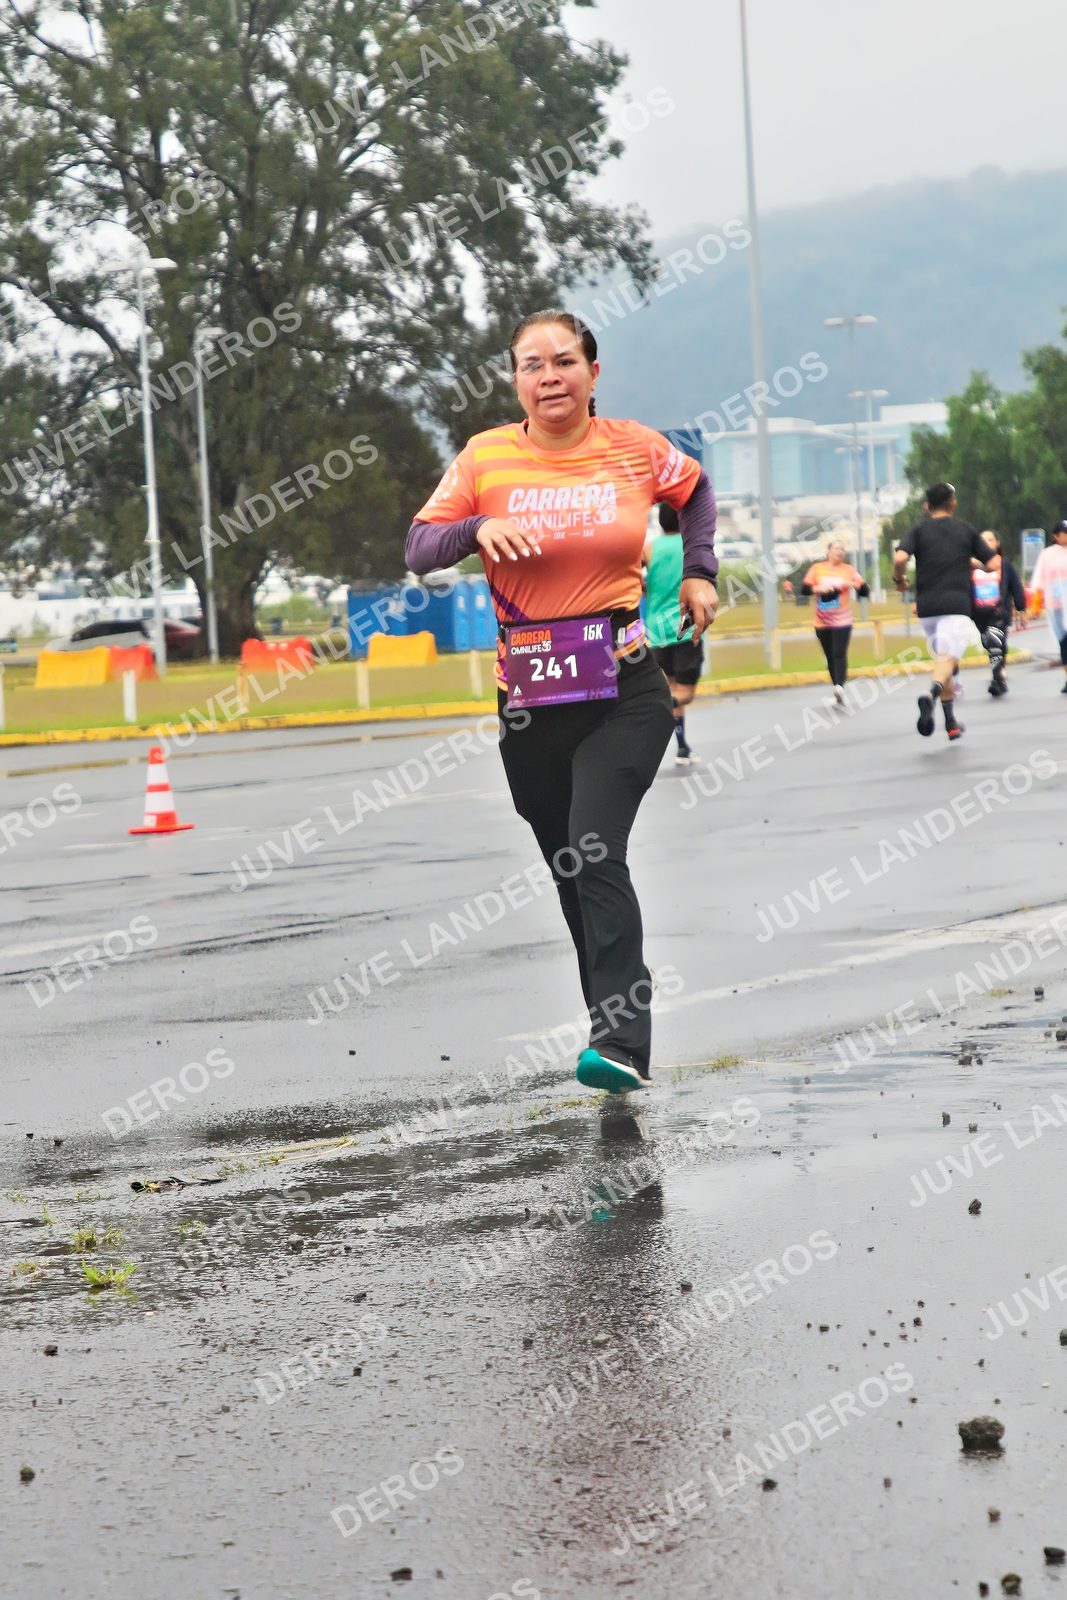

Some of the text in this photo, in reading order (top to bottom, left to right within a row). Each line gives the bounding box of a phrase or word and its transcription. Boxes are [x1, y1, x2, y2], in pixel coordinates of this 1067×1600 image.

[507, 481, 616, 513] CARRERA
[511, 629, 552, 646] CARRERA
[510, 644, 542, 655] OMNILIFE
[529, 654, 578, 682] 241
